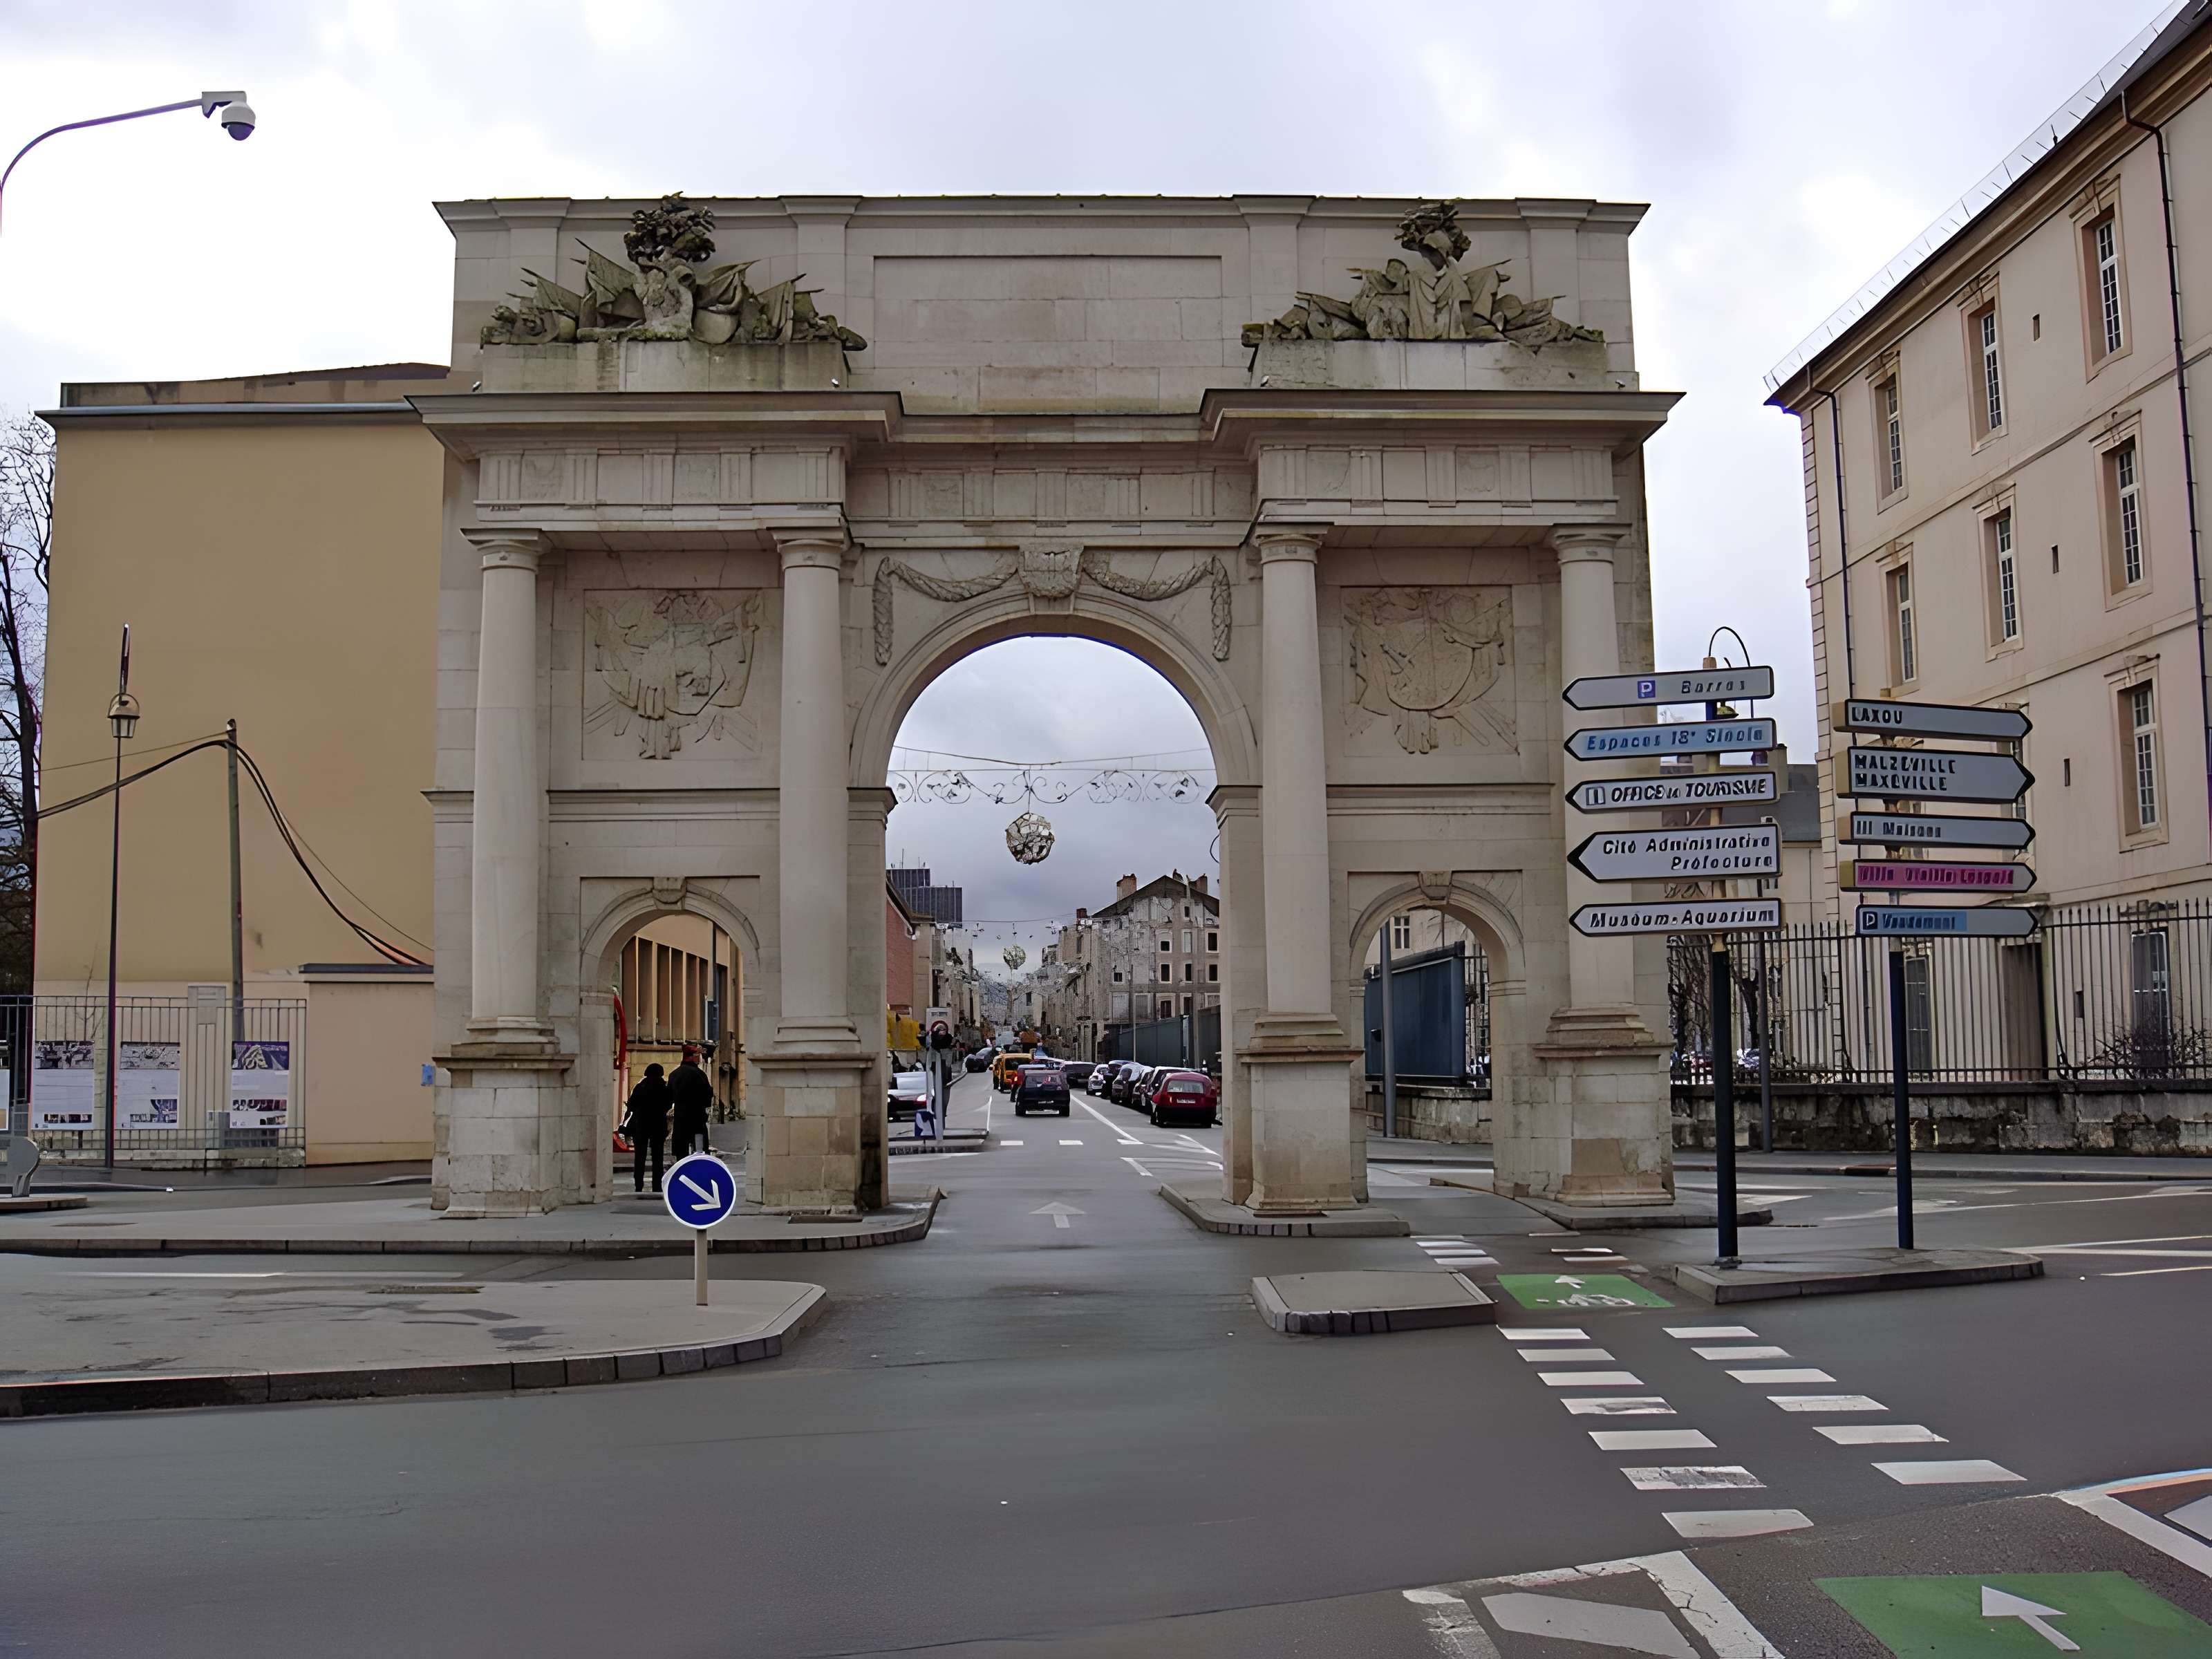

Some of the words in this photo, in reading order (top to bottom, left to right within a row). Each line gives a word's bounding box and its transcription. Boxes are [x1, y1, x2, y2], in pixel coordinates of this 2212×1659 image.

[1852, 706, 1902, 724] LAXOU
[1685, 778, 1767, 798] TOURISME
[1645, 832, 1770, 853] Administrative
